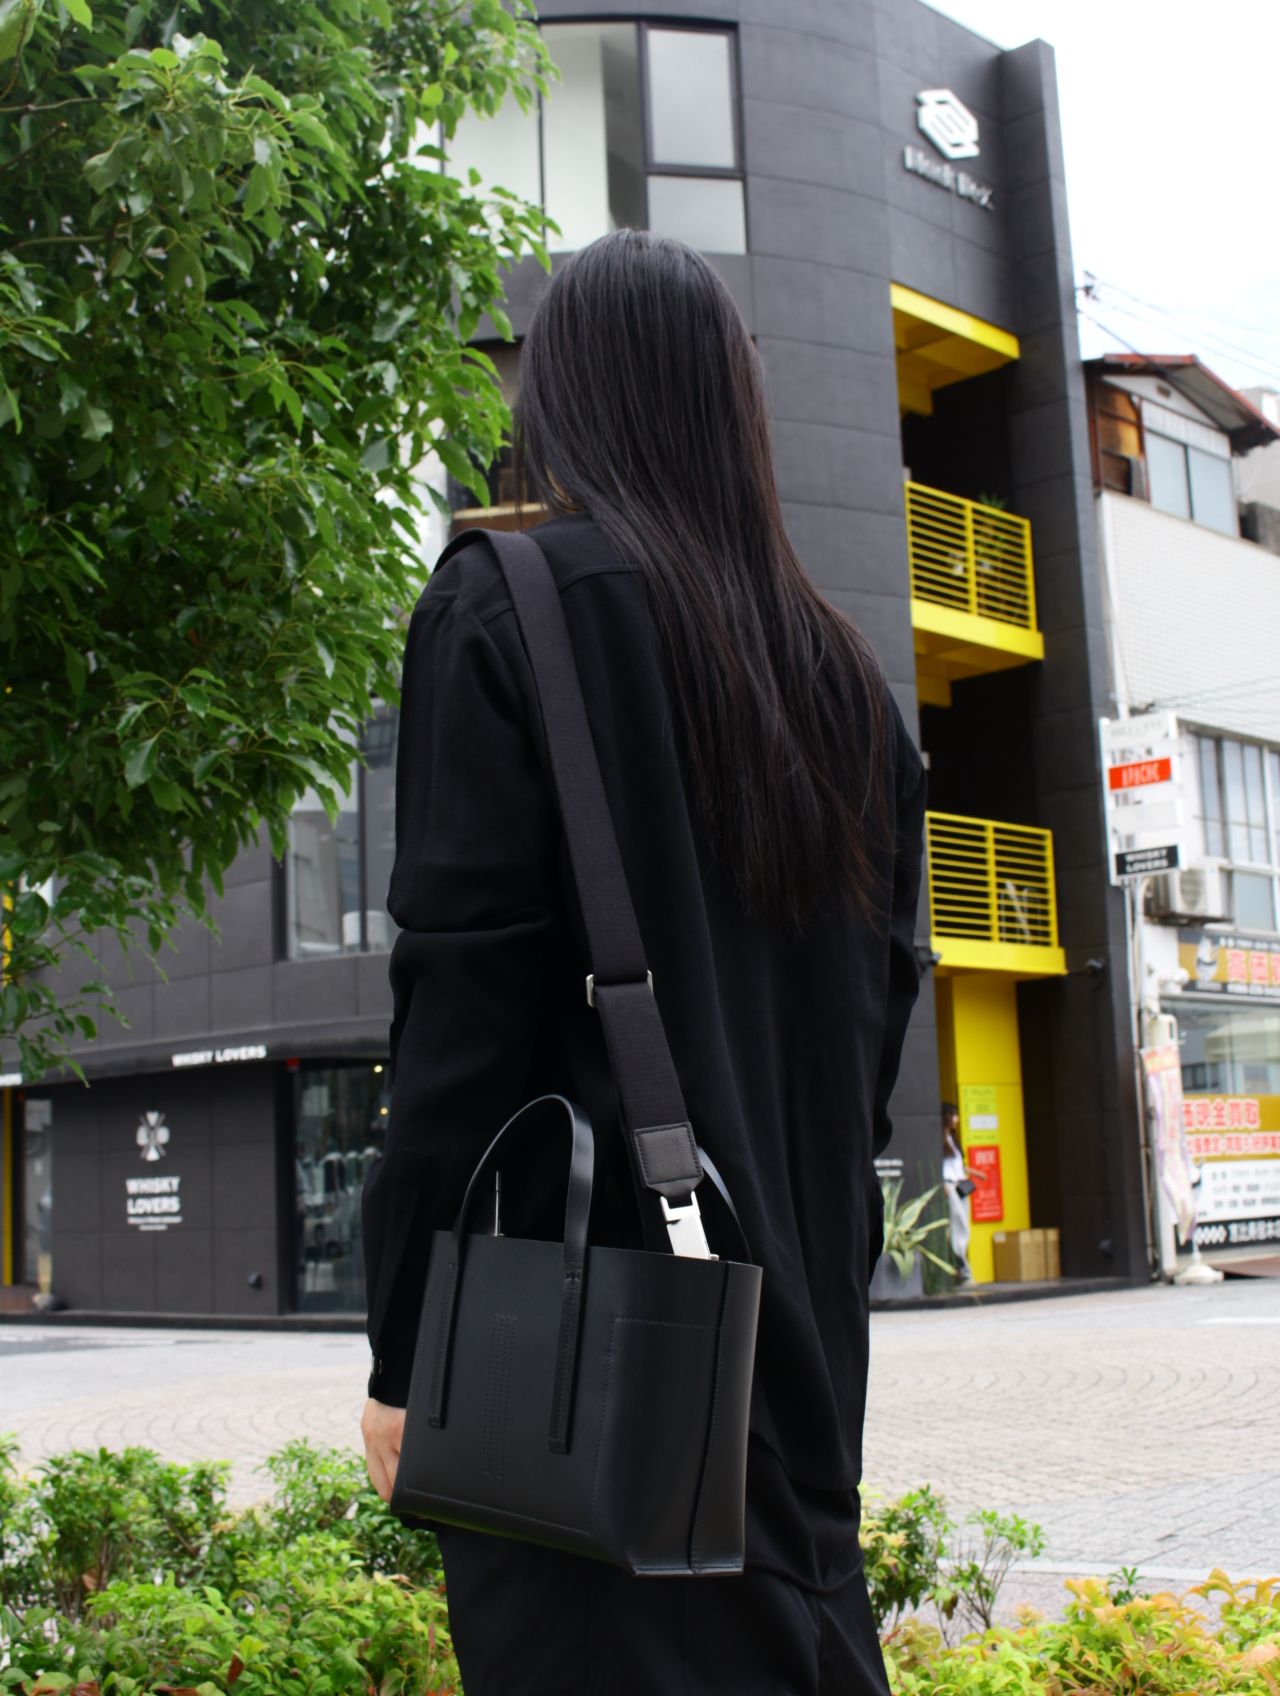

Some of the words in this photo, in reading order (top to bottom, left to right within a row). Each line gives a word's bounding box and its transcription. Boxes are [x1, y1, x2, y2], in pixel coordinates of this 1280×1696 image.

[1124, 849, 1168, 862] WHISKY
[1126, 859, 1169, 873] LOVERS
[172, 1050, 213, 1067] WHISKY
[215, 1044, 267, 1062] LOVERS
[126, 1176, 181, 1195] WHISKY
[126, 1196, 181, 1215] LOVERS
